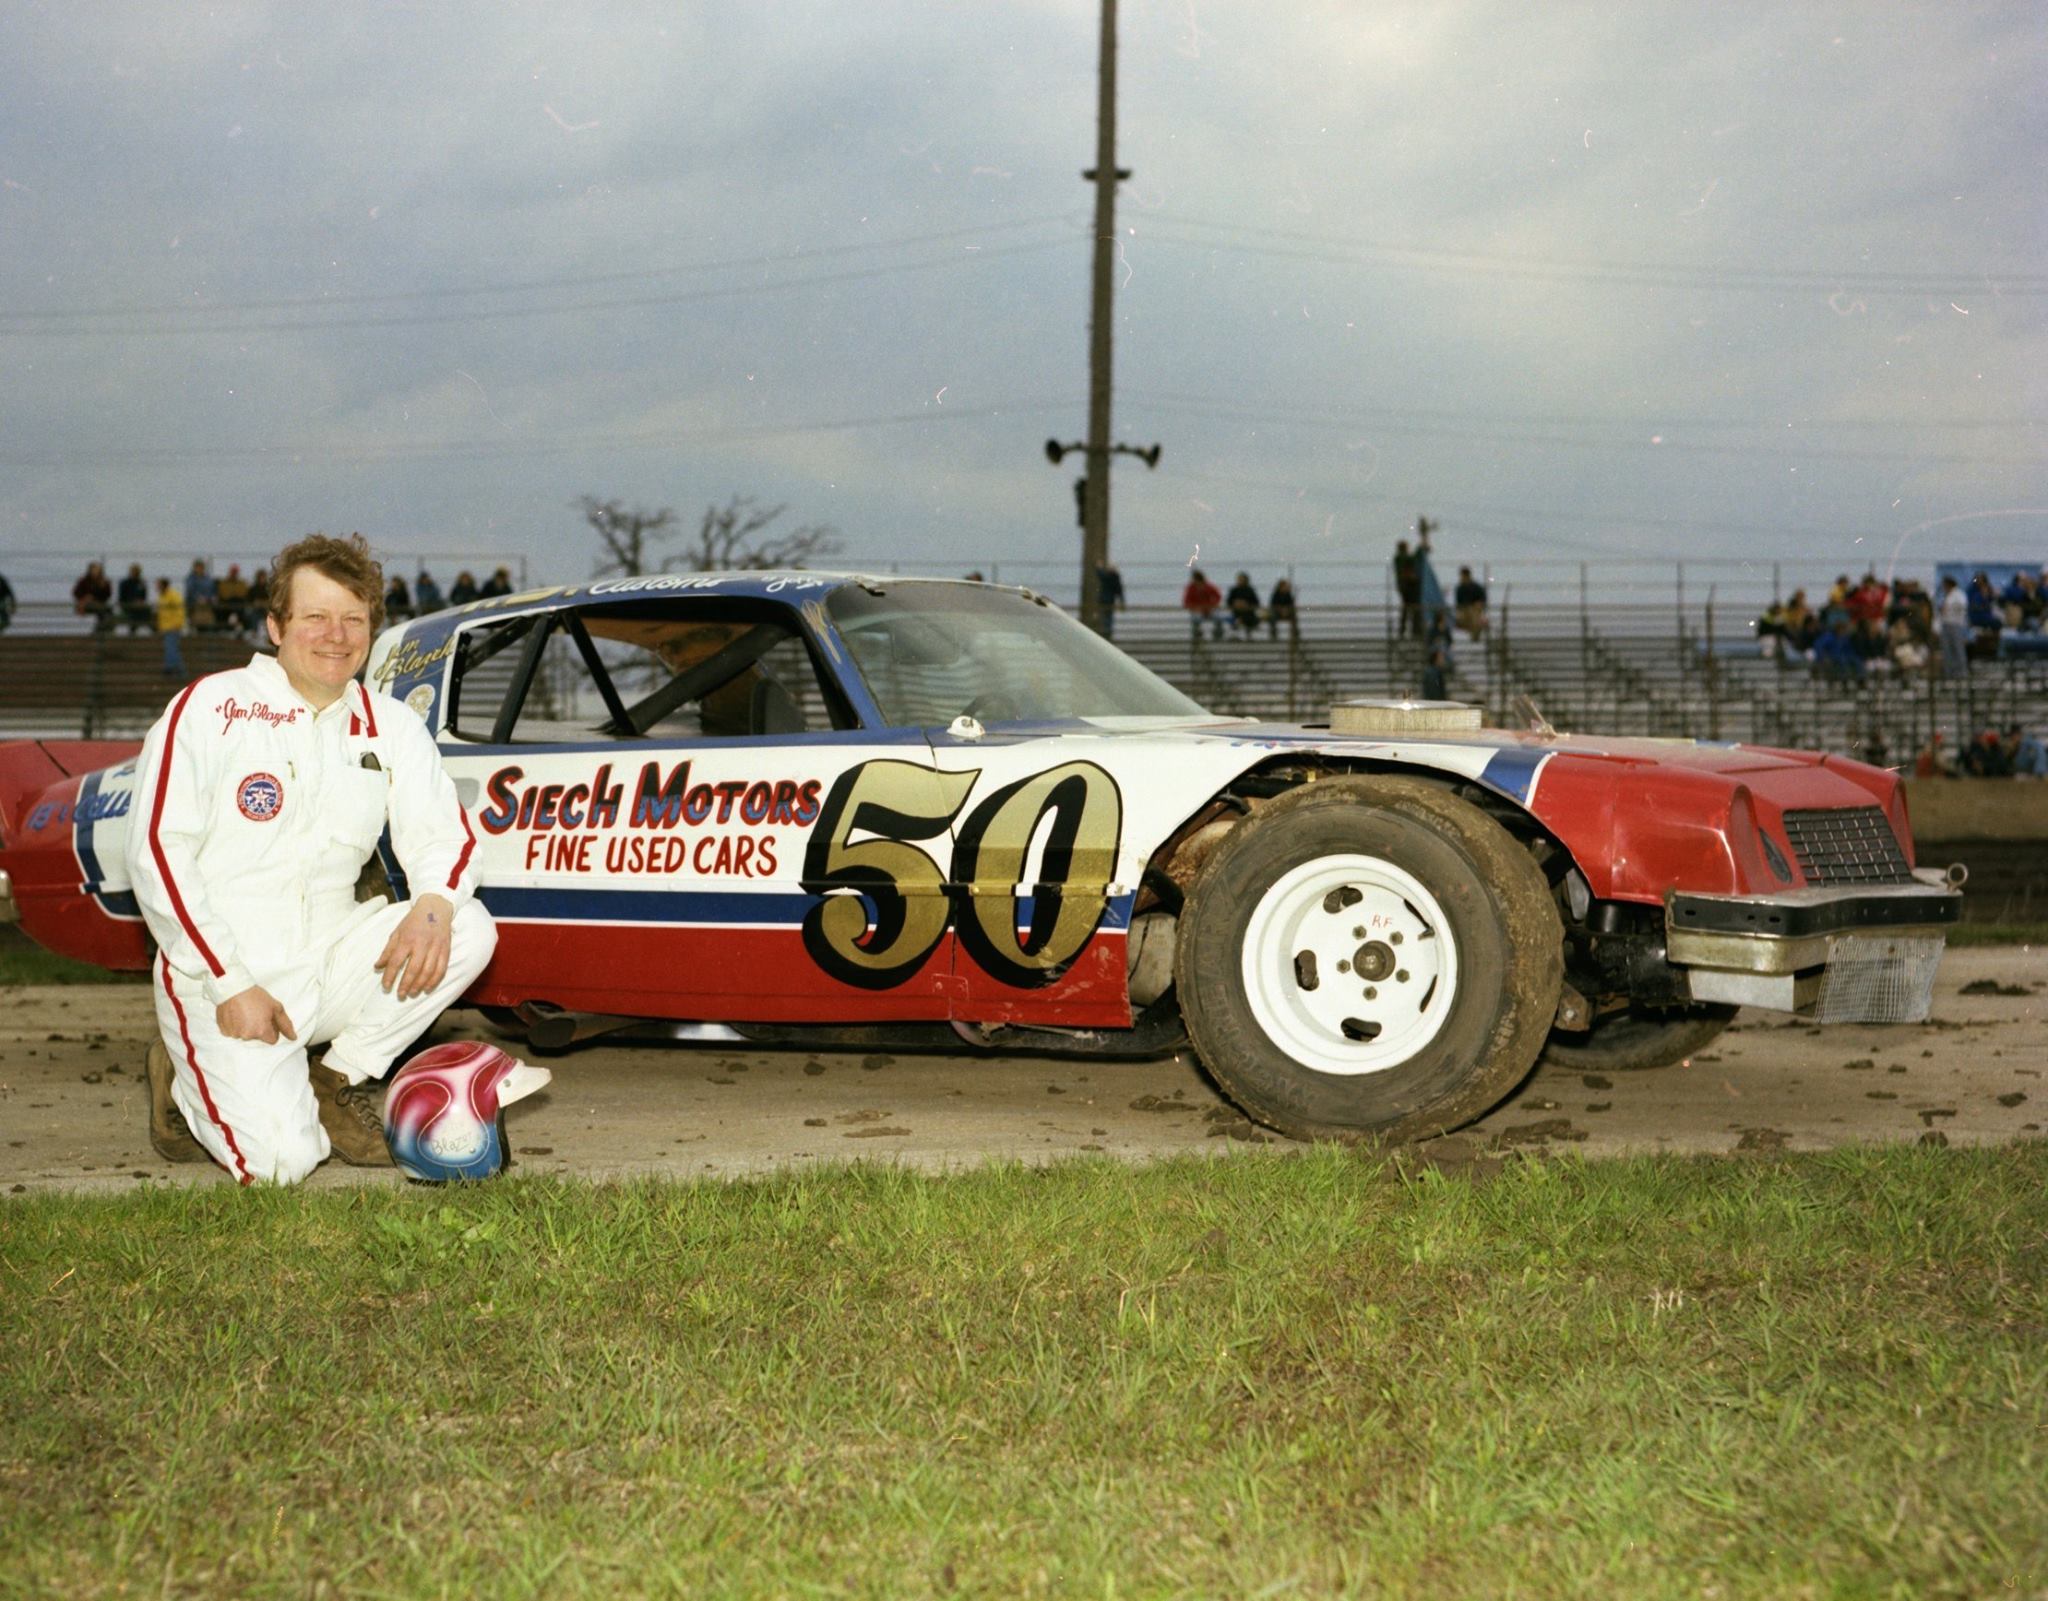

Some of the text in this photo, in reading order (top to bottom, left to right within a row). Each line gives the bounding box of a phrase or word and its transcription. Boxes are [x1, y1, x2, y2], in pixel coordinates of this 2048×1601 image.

[629, 759, 822, 831] MOTORS
[525, 834, 778, 877] FINE USED CARS
[800, 758, 1123, 990] 50
